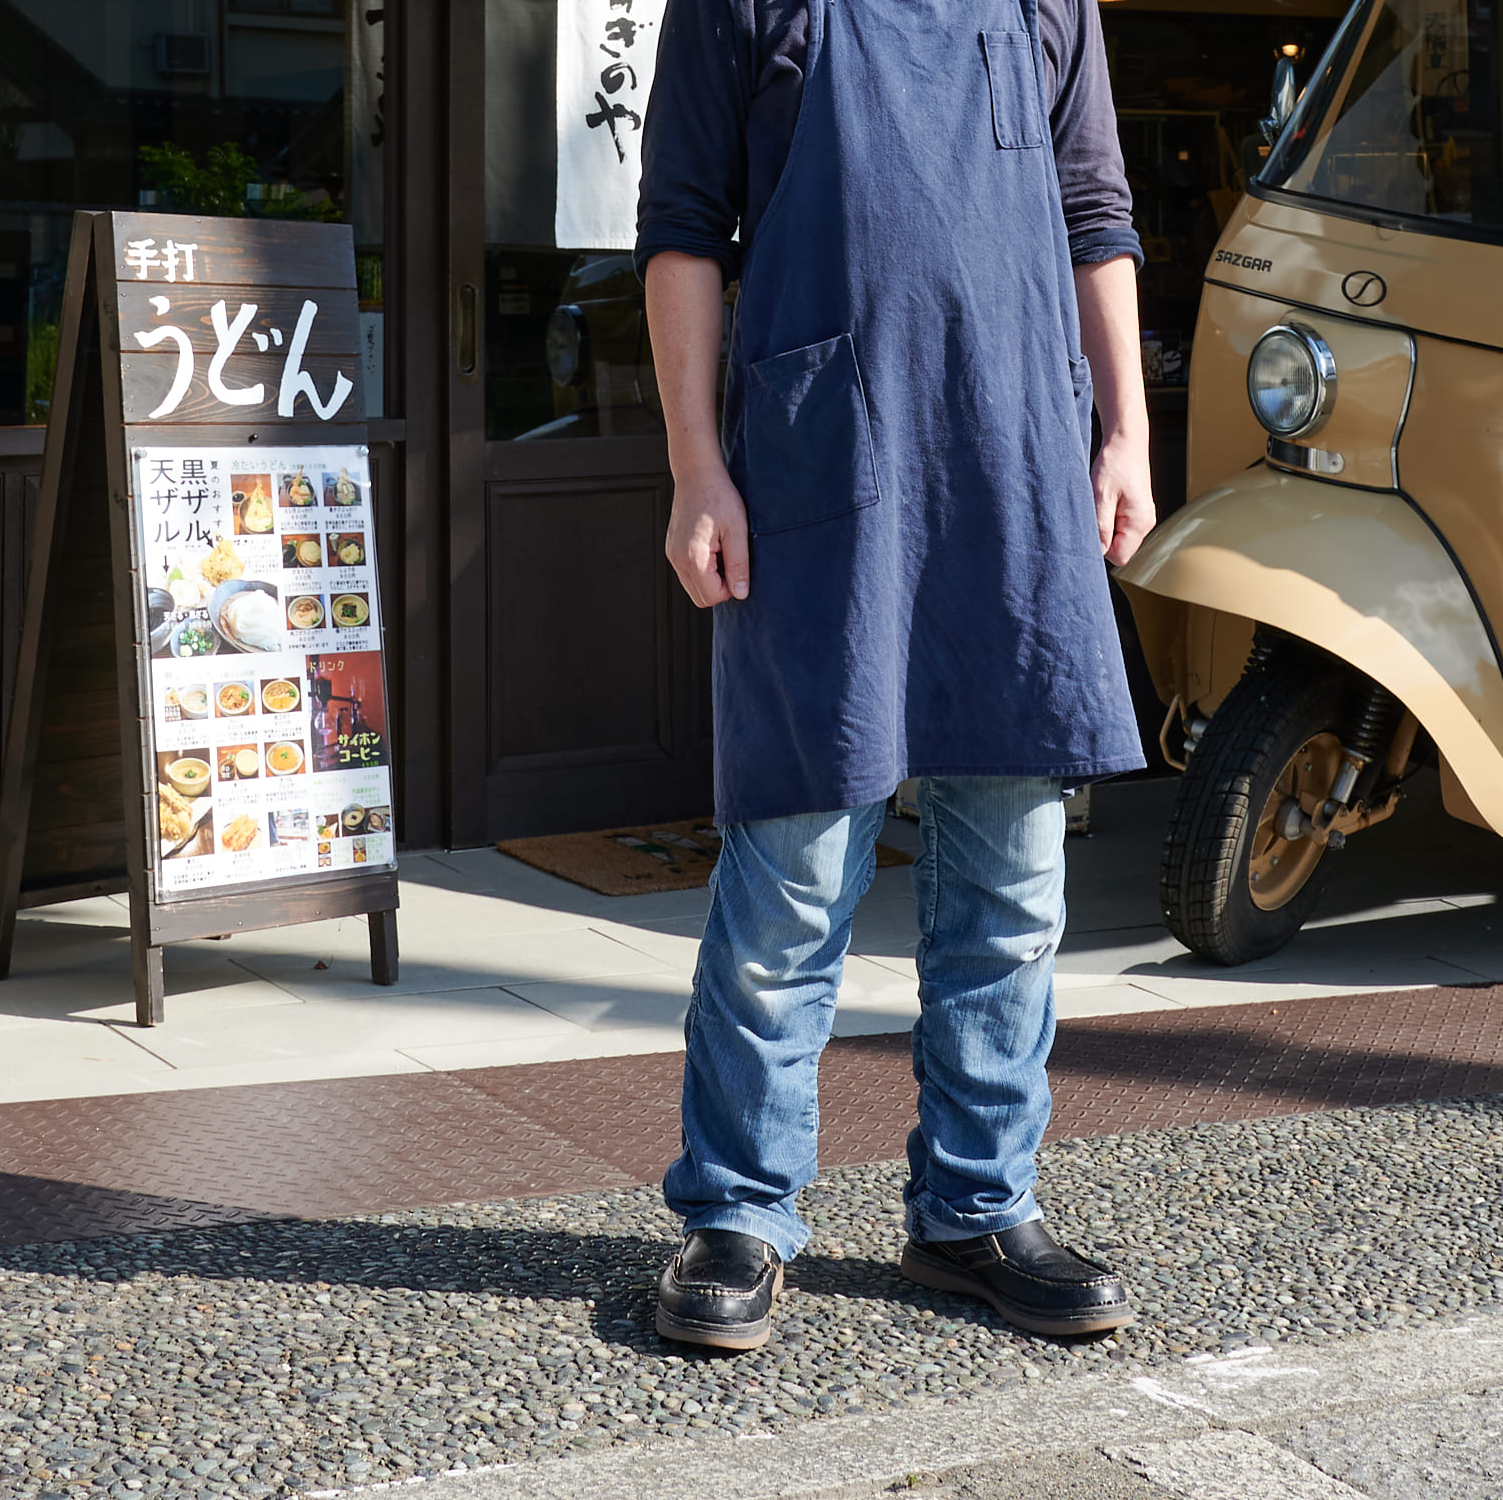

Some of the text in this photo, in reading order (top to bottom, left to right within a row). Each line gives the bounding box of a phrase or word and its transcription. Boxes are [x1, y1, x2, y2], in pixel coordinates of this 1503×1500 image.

[124, 238, 197, 283] 手打
[1215, 250, 1273, 272] SAZGAR
[134, 296, 353, 421] うどん
[150, 459, 181, 543] 天ザル
[180, 459, 208, 542] 黒ザル
[309, 659, 345, 673] ドリンク
[337, 731, 381, 747] サイホン
[340, 747, 381, 763] コーヒー
